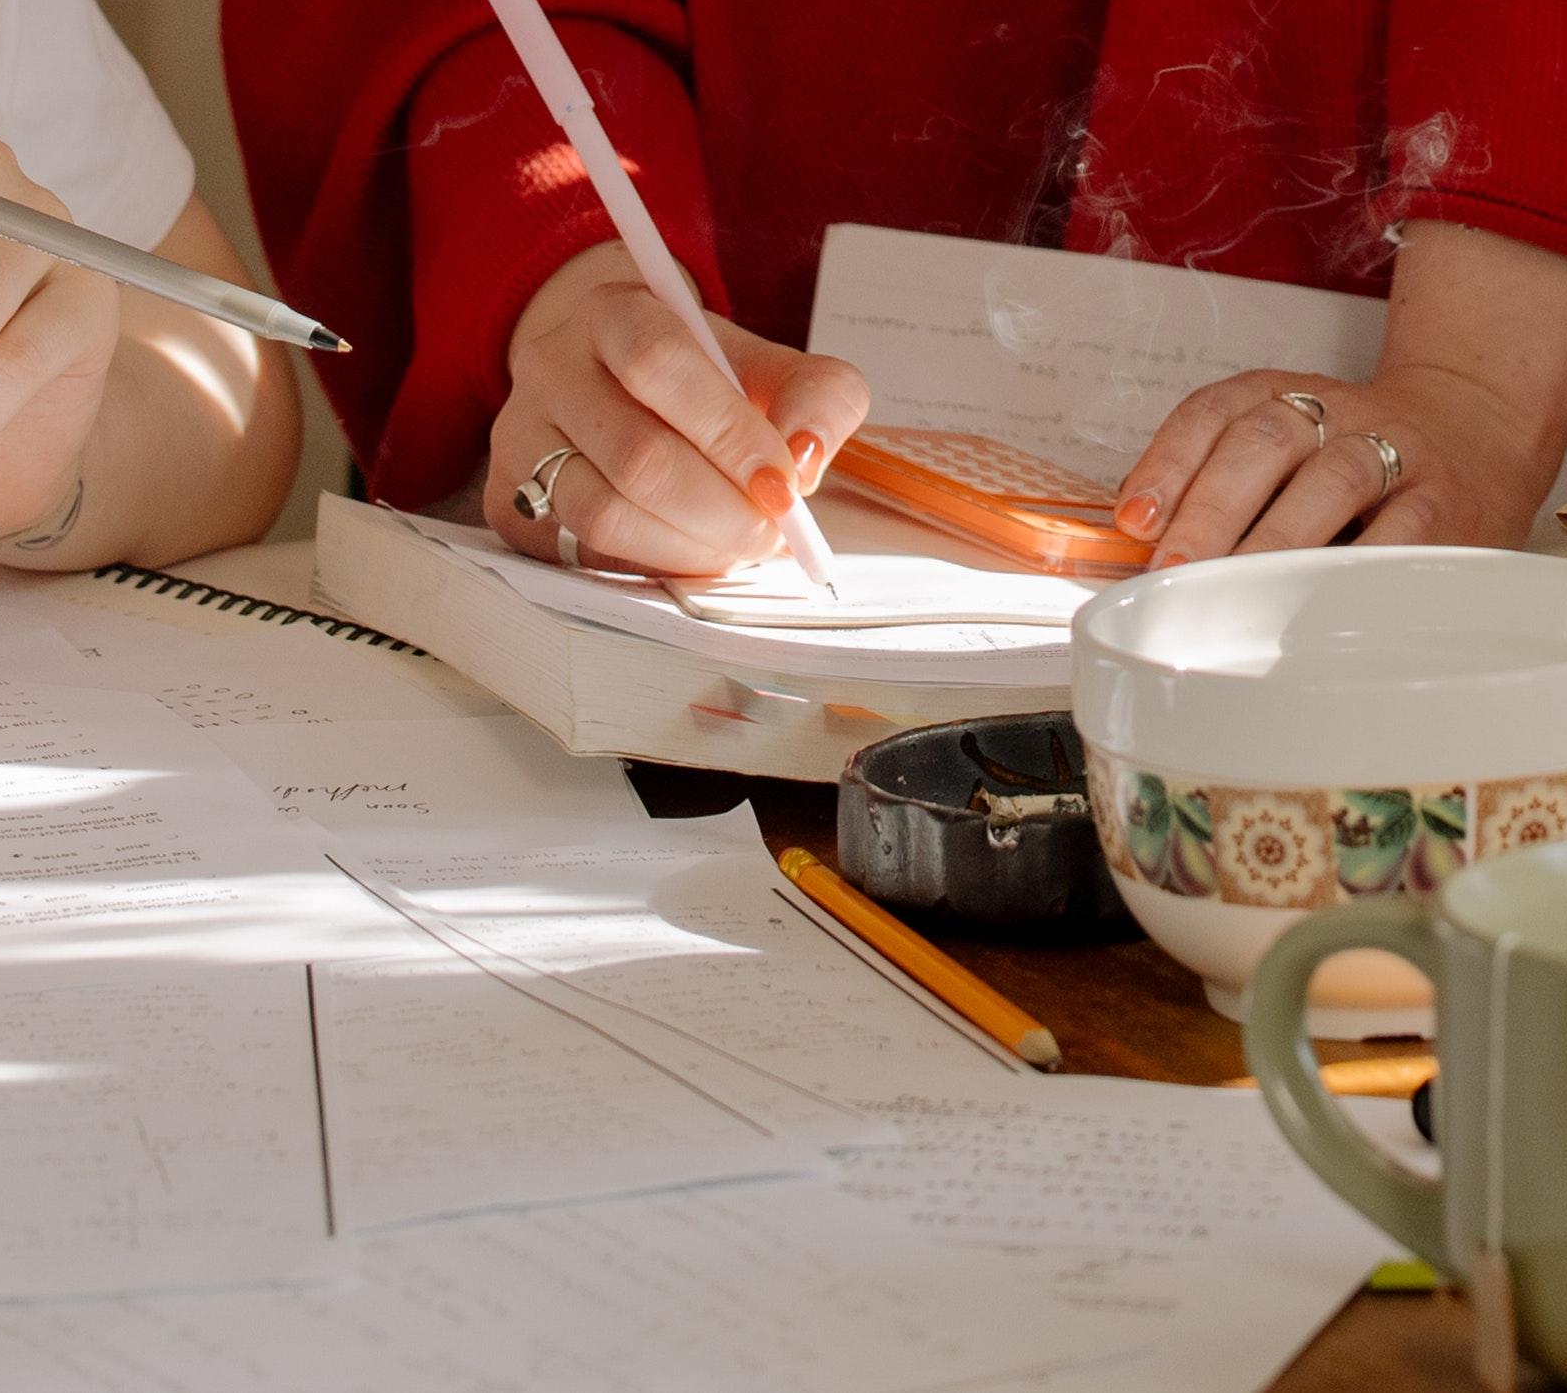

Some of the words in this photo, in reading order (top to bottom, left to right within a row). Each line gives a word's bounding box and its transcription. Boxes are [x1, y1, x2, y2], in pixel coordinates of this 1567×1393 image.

[24, 742, 55, 750] ohm
[78, 806, 114, 814] short
[47, 817, 124, 829] appliances
[115, 843, 150, 852] short
[33, 852, 78, 861] series
[104, 853, 166, 865] negative
[93, 861, 149, 873] positive
[20, 870, 89, 881] terminals
